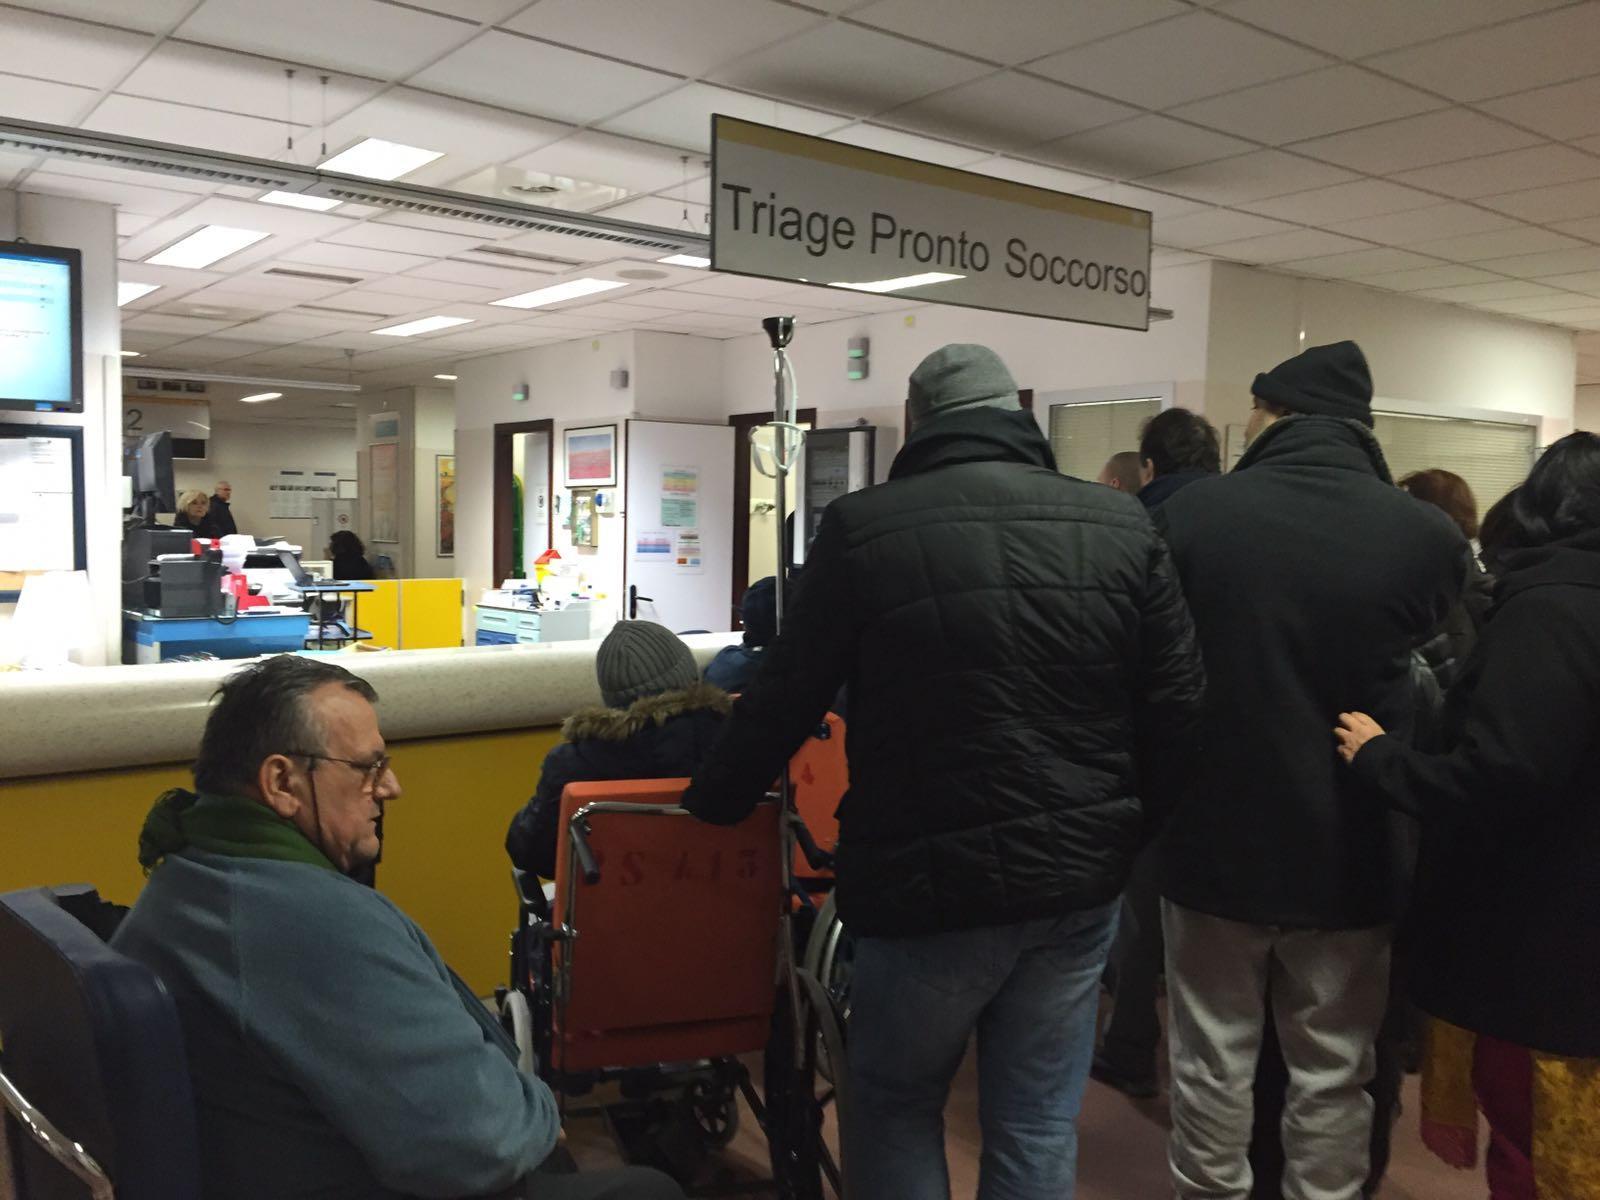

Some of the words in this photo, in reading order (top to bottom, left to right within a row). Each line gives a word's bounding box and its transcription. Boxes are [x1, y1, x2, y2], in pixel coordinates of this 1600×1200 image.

[721, 182, 856, 258] Triage
[870, 211, 990, 273] Pronto
[1004, 237, 1148, 298] Soccorso
